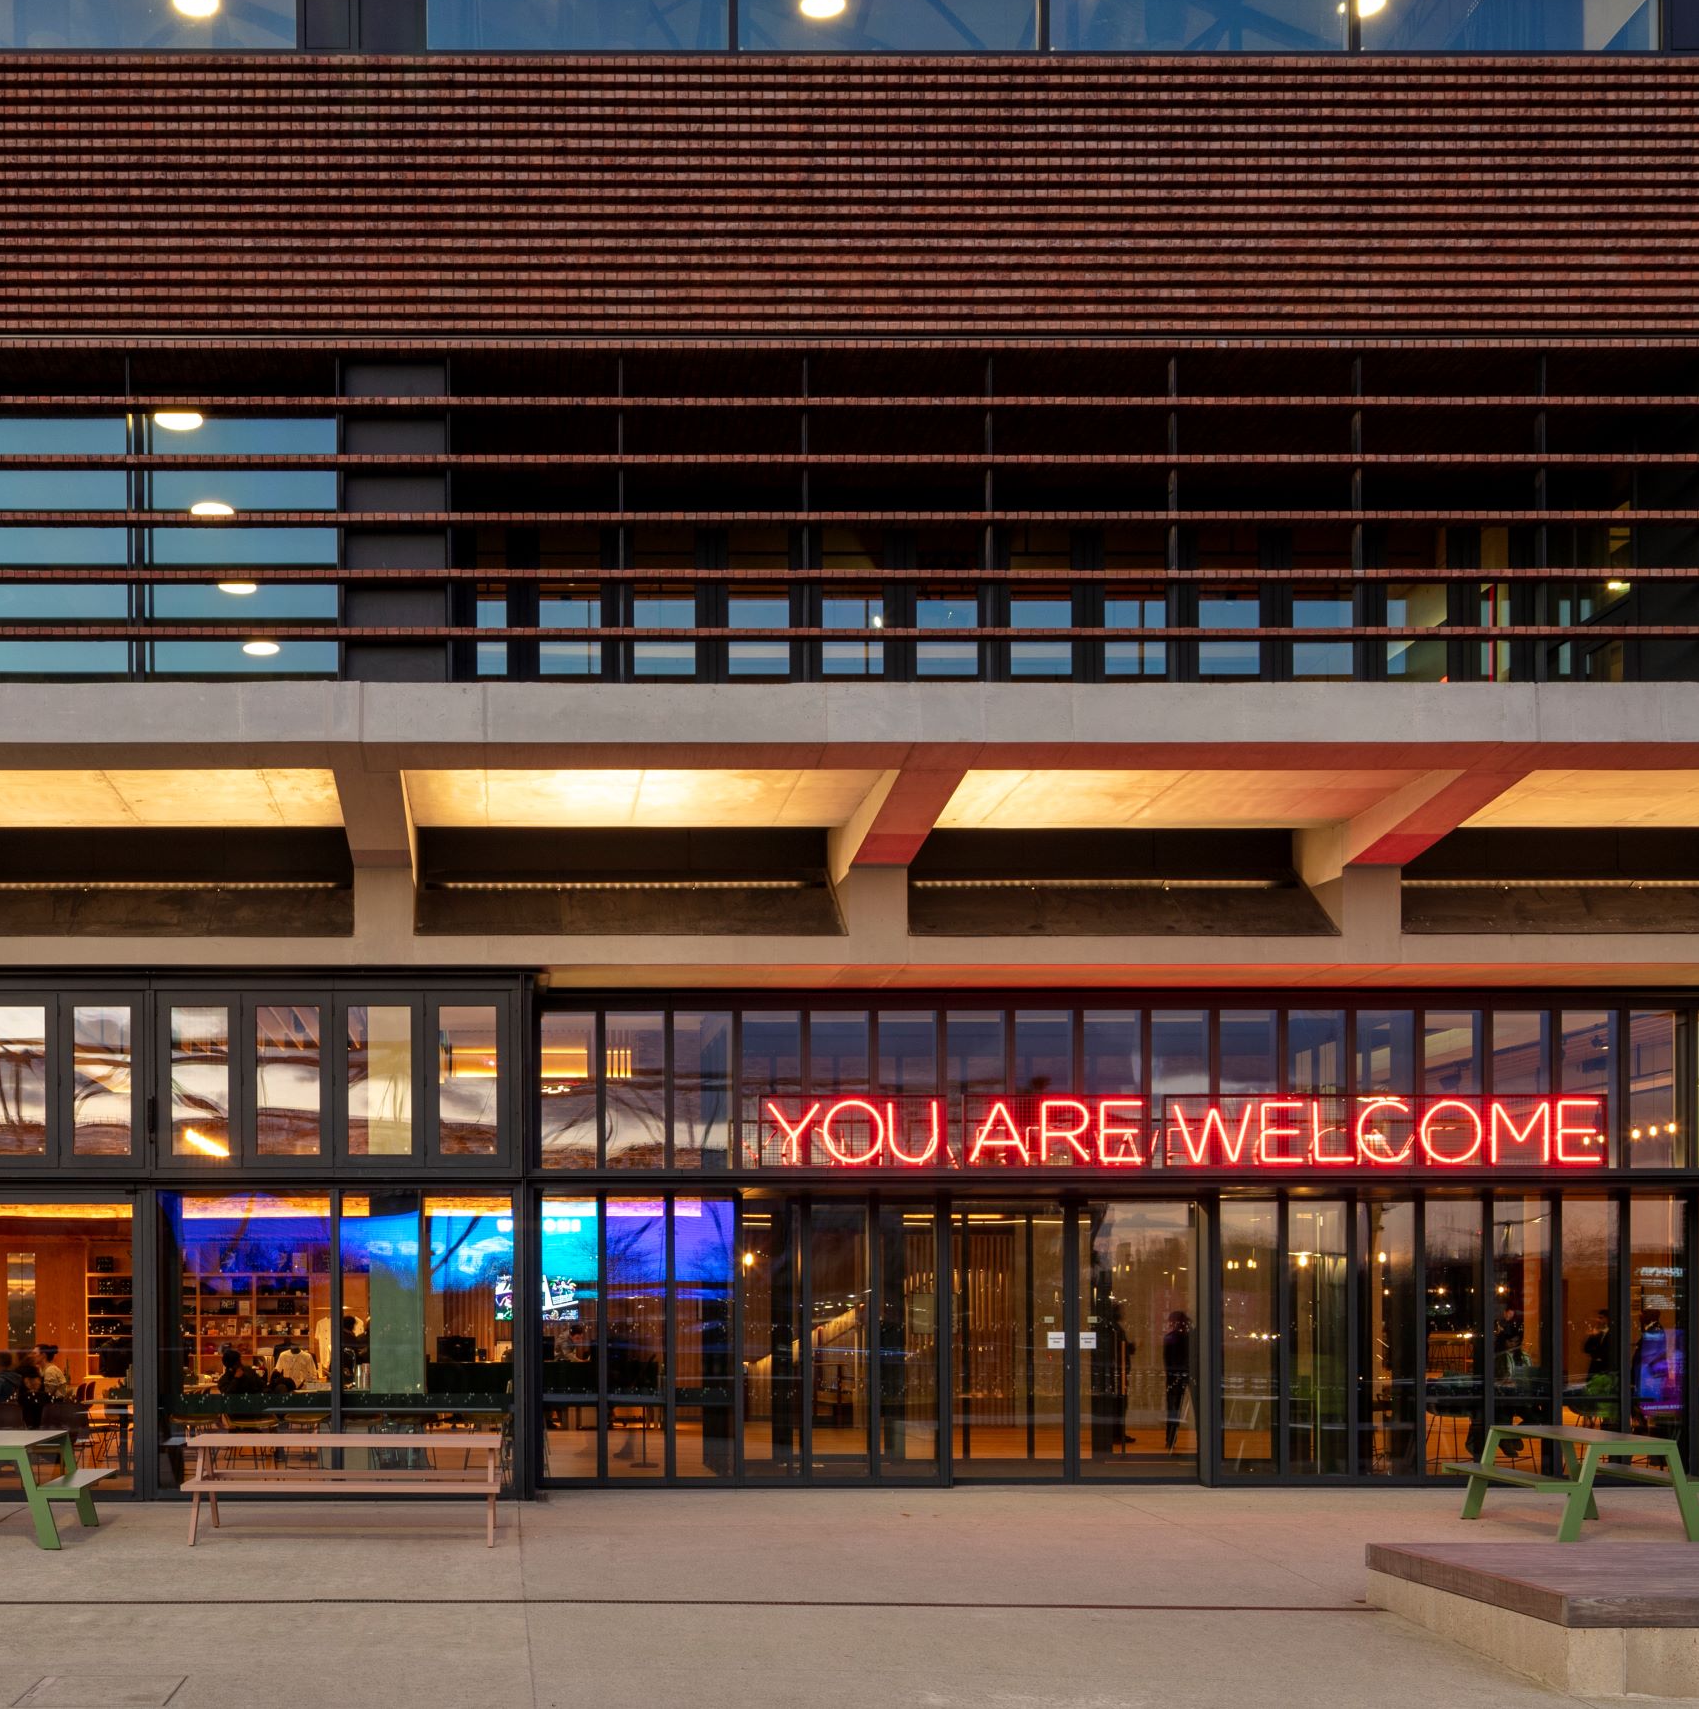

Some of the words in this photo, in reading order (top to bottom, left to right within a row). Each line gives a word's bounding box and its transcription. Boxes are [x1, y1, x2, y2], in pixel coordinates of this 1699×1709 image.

[768, 1100, 938, 1163] YOU
[969, 1100, 1143, 1163] ARE
[1173, 1099, 1602, 1163] WELCOME
